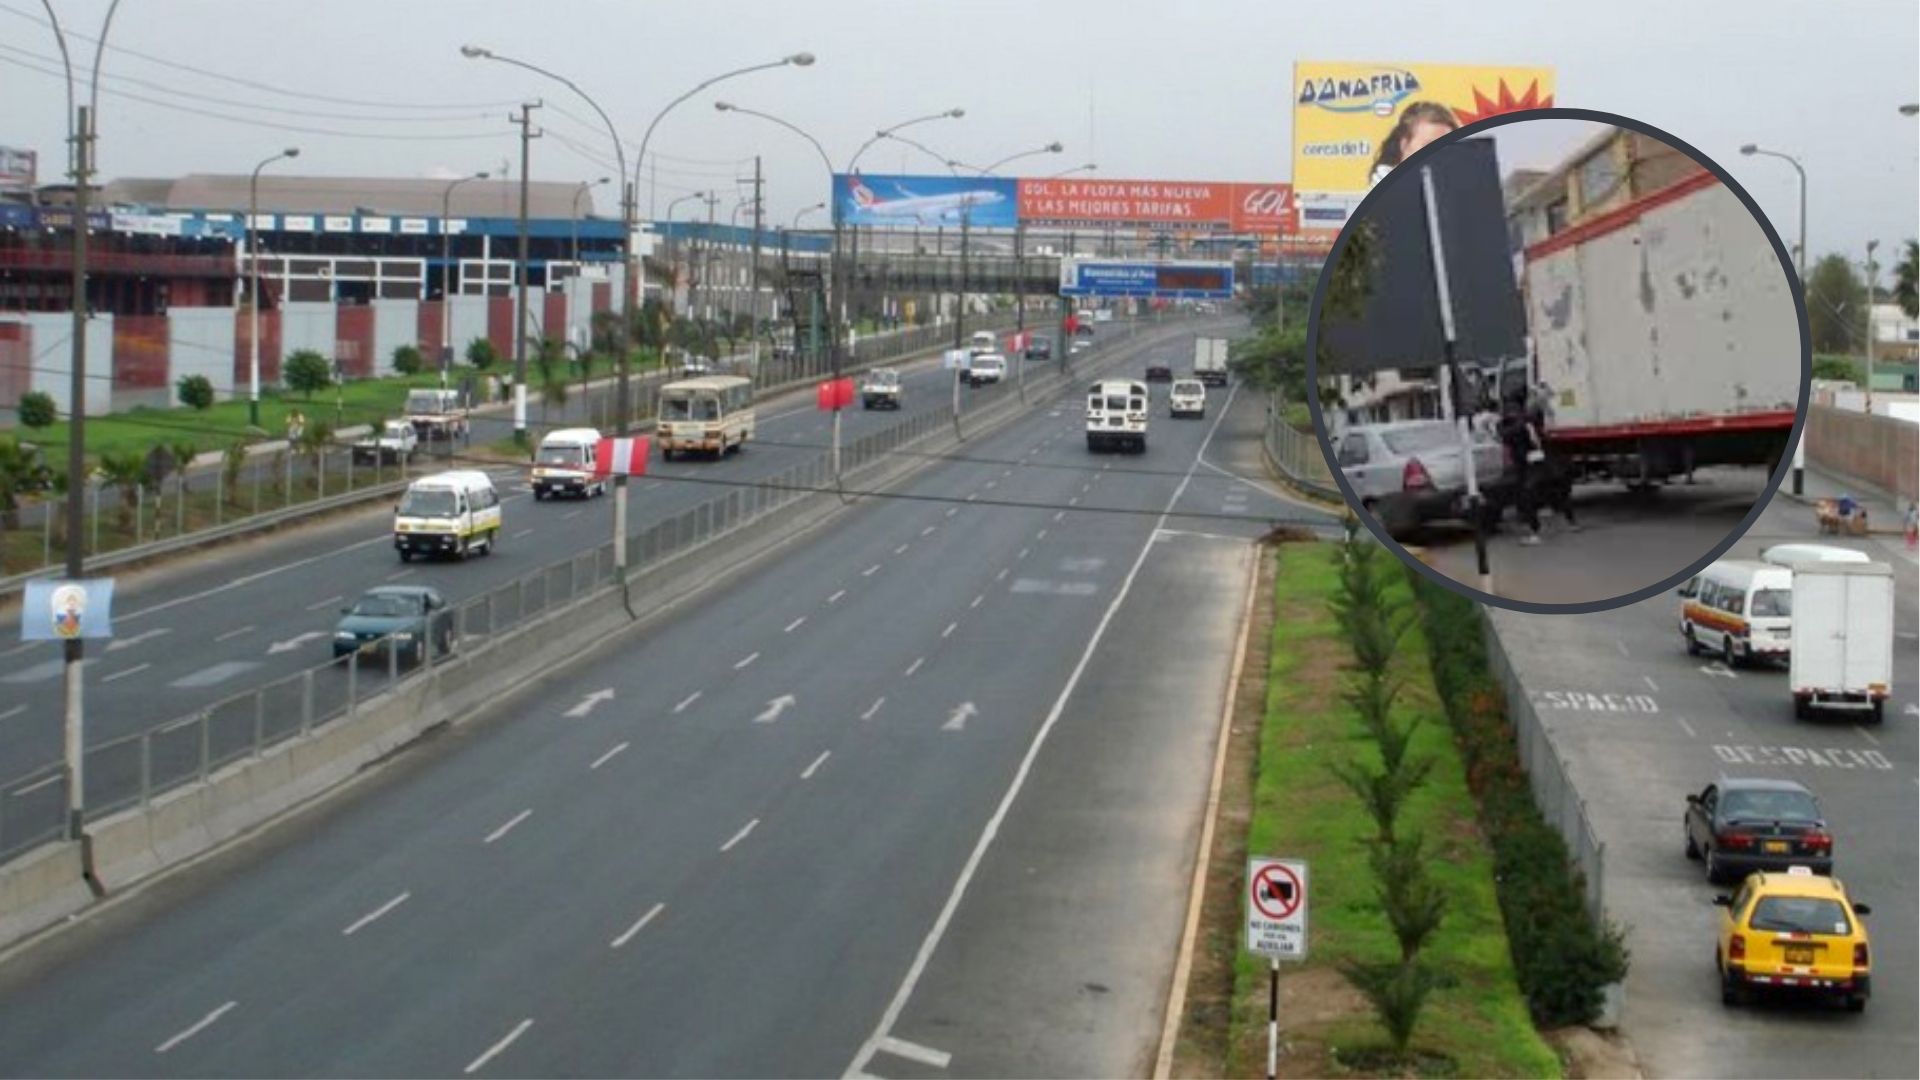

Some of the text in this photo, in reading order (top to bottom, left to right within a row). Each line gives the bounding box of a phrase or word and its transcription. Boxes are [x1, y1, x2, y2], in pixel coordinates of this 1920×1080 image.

[1303, 144, 1339, 155] cerca
[1062, 184, 1078, 196] LA
[1082, 184, 1125, 197] FLOTA
[1163, 185, 1211, 199] NUEVA
[1024, 200, 1032, 212] Y
[1037, 200, 1065, 213] LAS
[1068, 201, 1130, 216] MEJORES
[1243, 189, 1291, 216] GOL
[1712, 744, 1893, 769] DESPACIO
